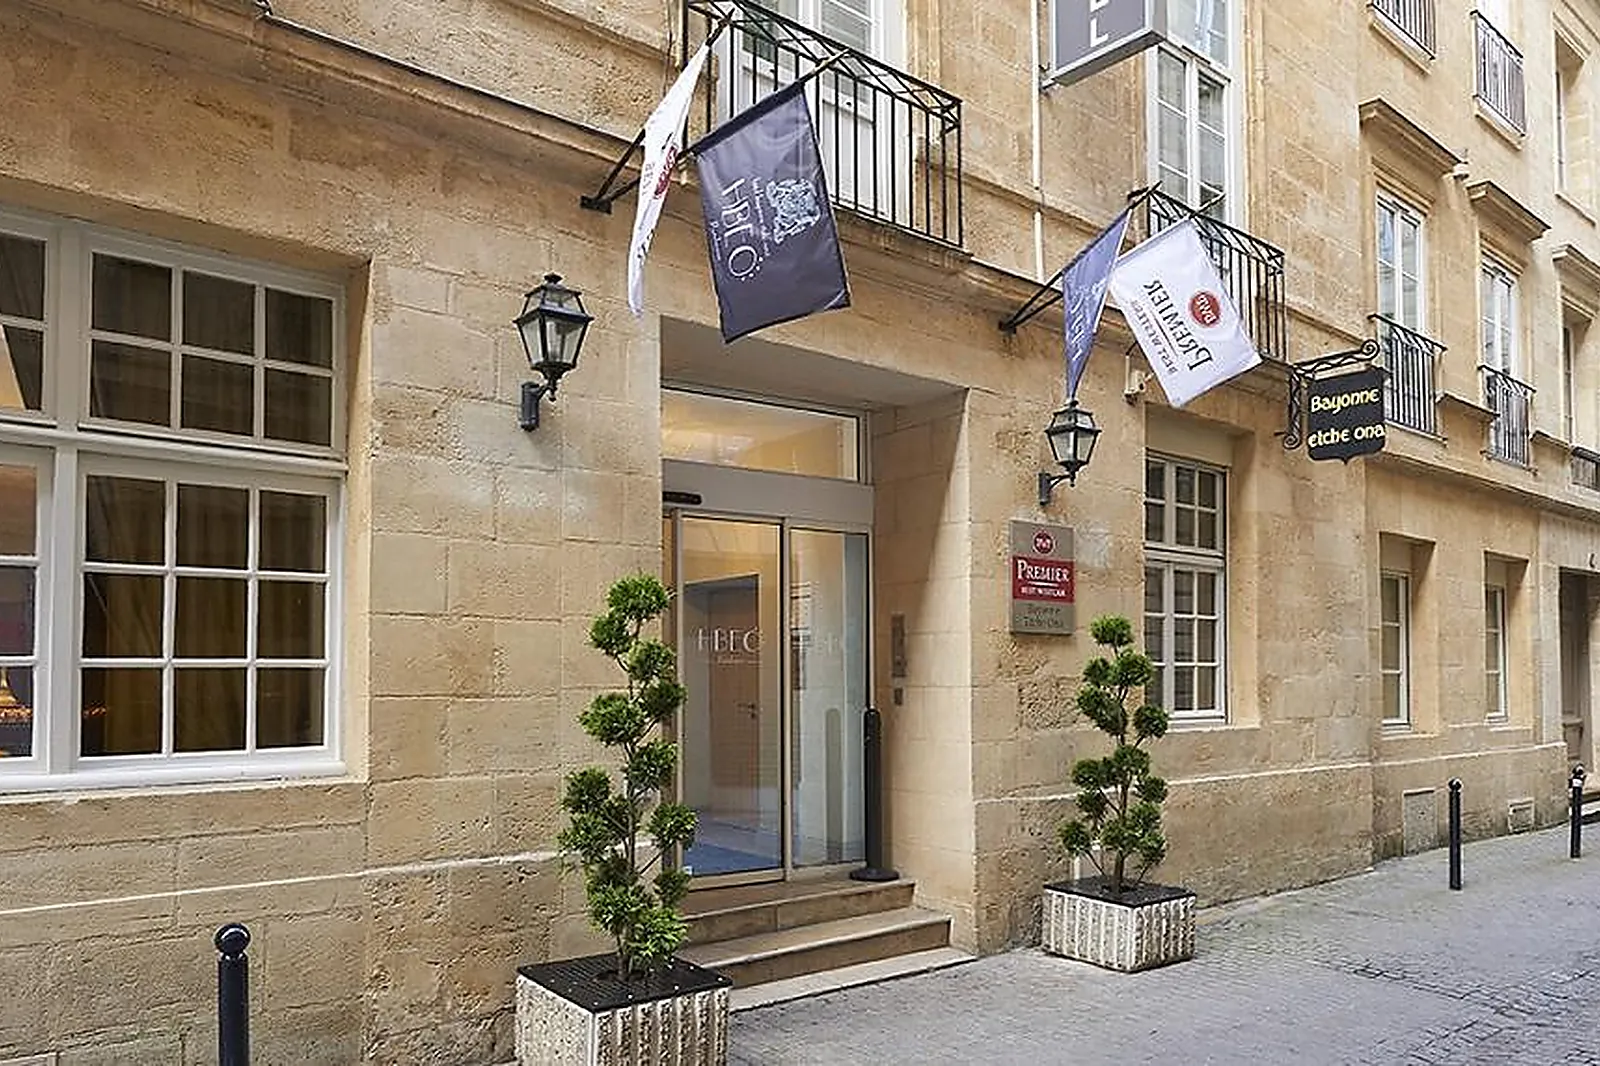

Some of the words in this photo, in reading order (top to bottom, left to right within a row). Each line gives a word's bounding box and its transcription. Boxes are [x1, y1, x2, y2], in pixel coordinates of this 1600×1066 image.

[1311, 388, 1379, 415] Bayonne
[1353, 424, 1386, 440] ona
[1017, 559, 1070, 582] PREMIER
